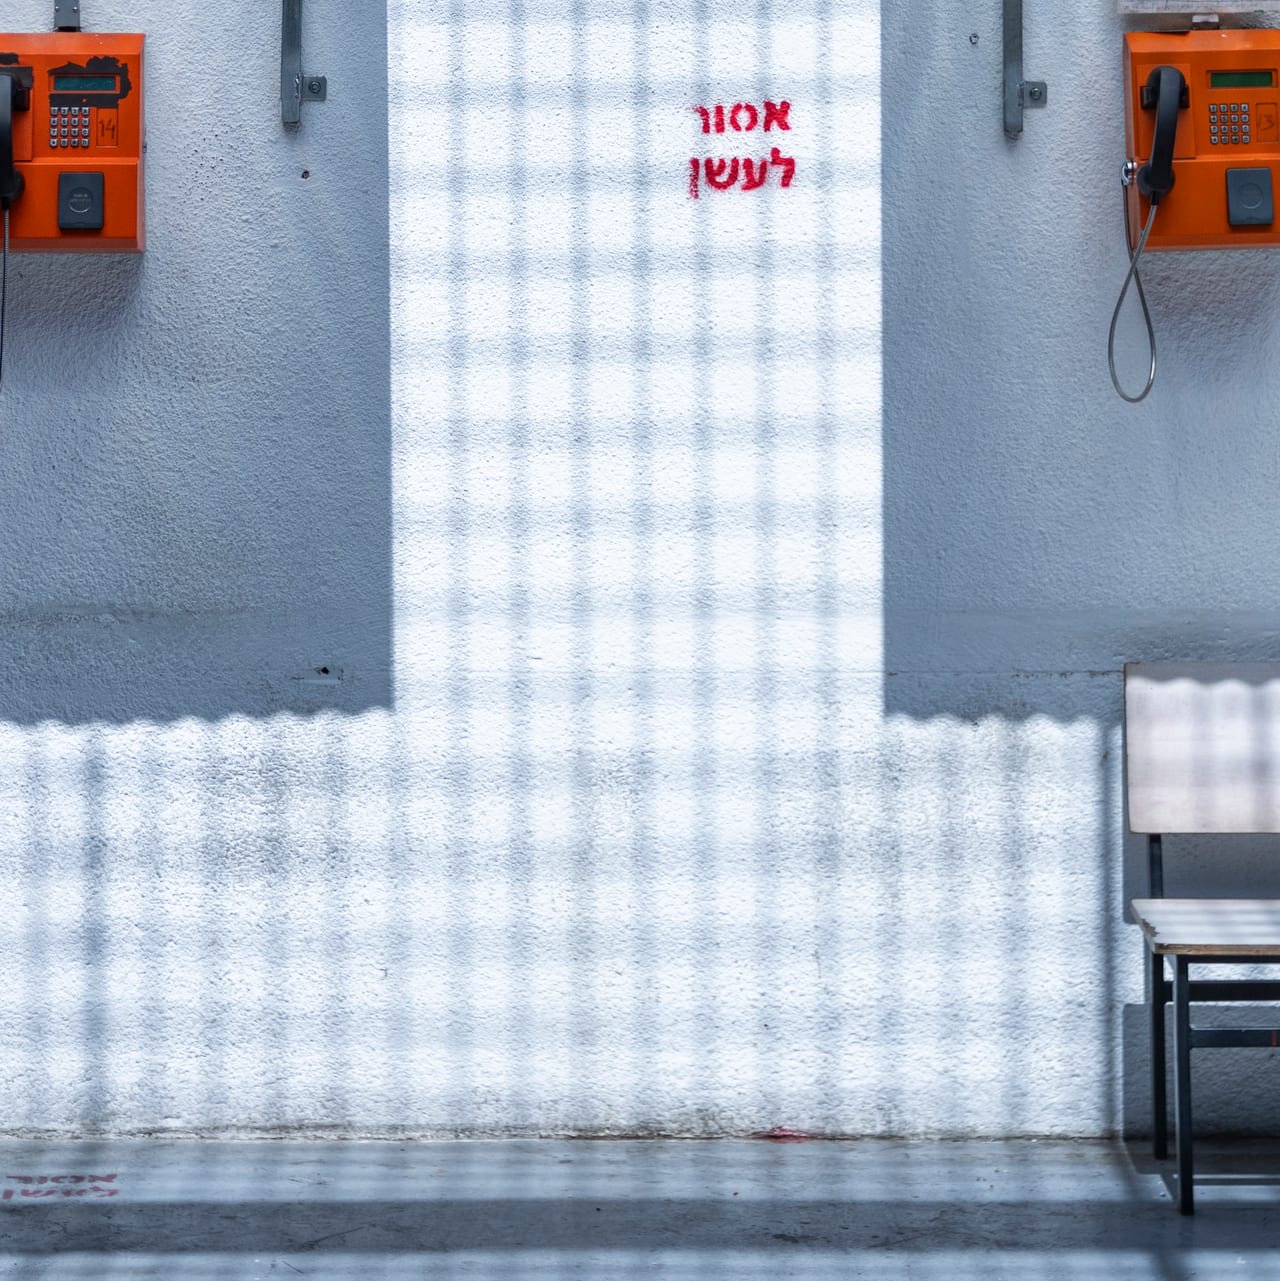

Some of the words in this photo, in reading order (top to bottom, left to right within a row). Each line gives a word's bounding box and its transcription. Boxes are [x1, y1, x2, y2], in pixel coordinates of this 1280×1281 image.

[99, 118, 116, 140] 14
[690, 99, 792, 134] אסור
[689, 146, 796, 200] לעשן
